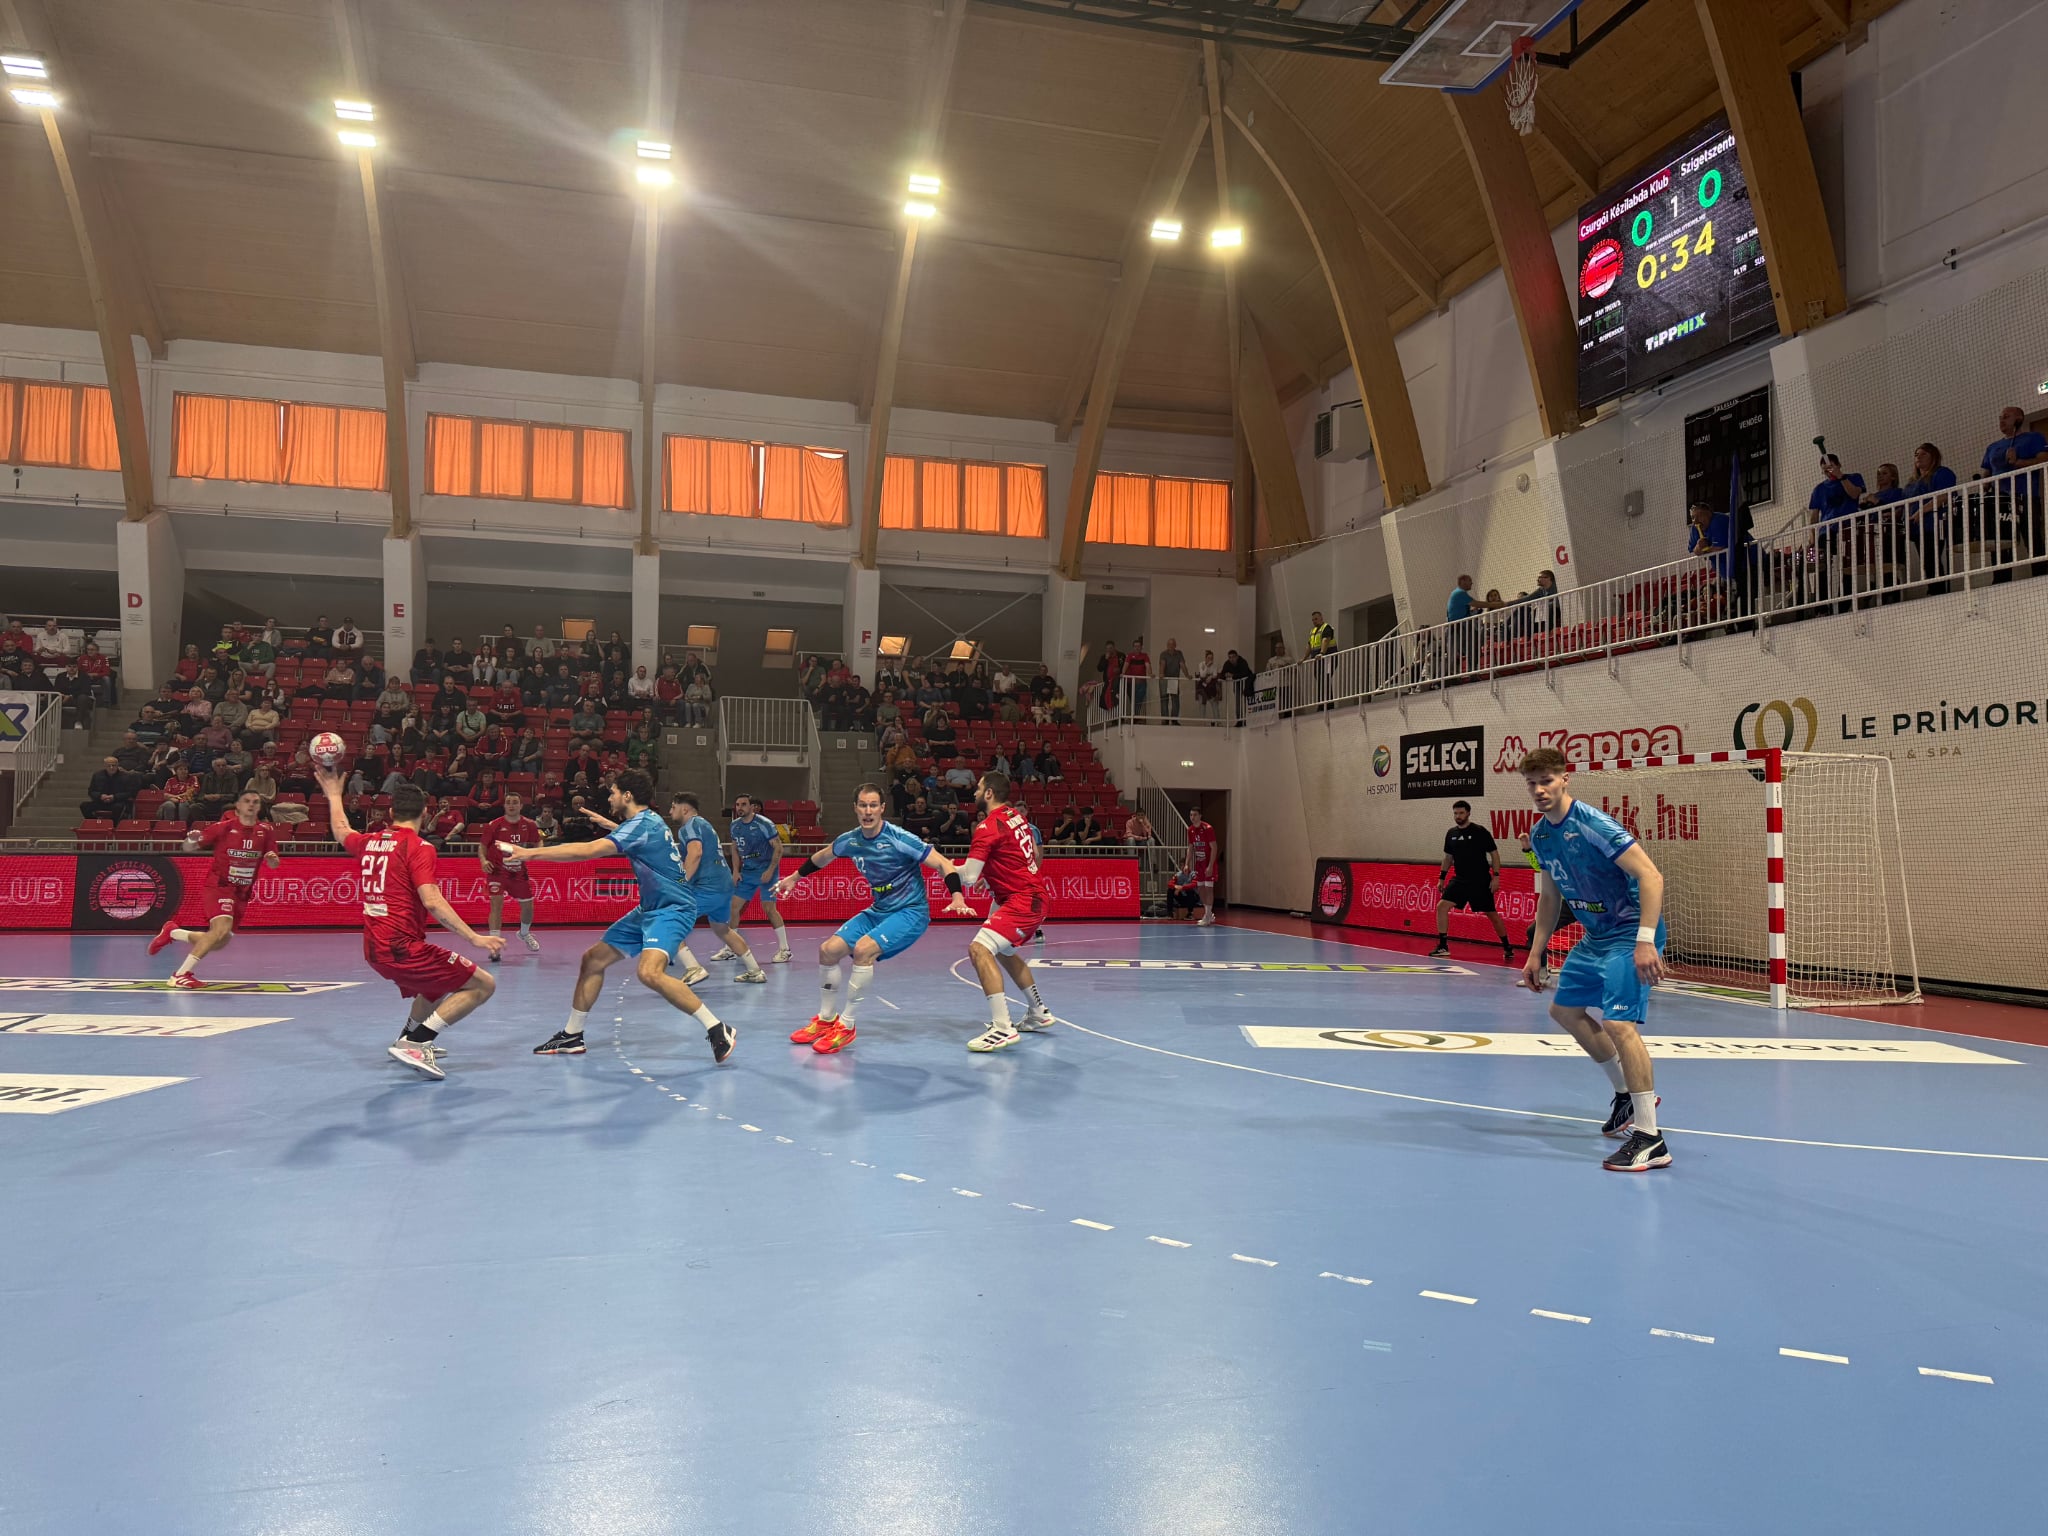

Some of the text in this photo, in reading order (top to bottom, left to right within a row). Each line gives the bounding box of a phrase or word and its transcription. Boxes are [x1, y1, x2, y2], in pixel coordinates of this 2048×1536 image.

[1698, 168, 1722, 208] 0
[1580, 175, 1669, 238] Csurgói Kézilabda Klub
[1670, 195, 1678, 218] 1
[1631, 210, 1653, 247] 0
[1637, 220, 1715, 288] 0:34
[1556, 545, 1569, 565] G
[127, 592, 143, 608] D
[393, 603, 405, 618] E
[861, 630, 872, 644] F
[1841, 700, 2048, 739] LE PRiMOR
[1538, 724, 1684, 764] Kappa
[1927, 746, 1962, 758] SPA
[1406, 740, 1478, 775] SELECT
[1366, 783, 1398, 795] HS SPORT
[242, 839, 253, 849] 10
[510, 834, 521, 843] 33
[361, 854, 389, 893] 23
[1545, 858, 1569, 881] 23
[1062, 876, 1132, 900] KLUB
